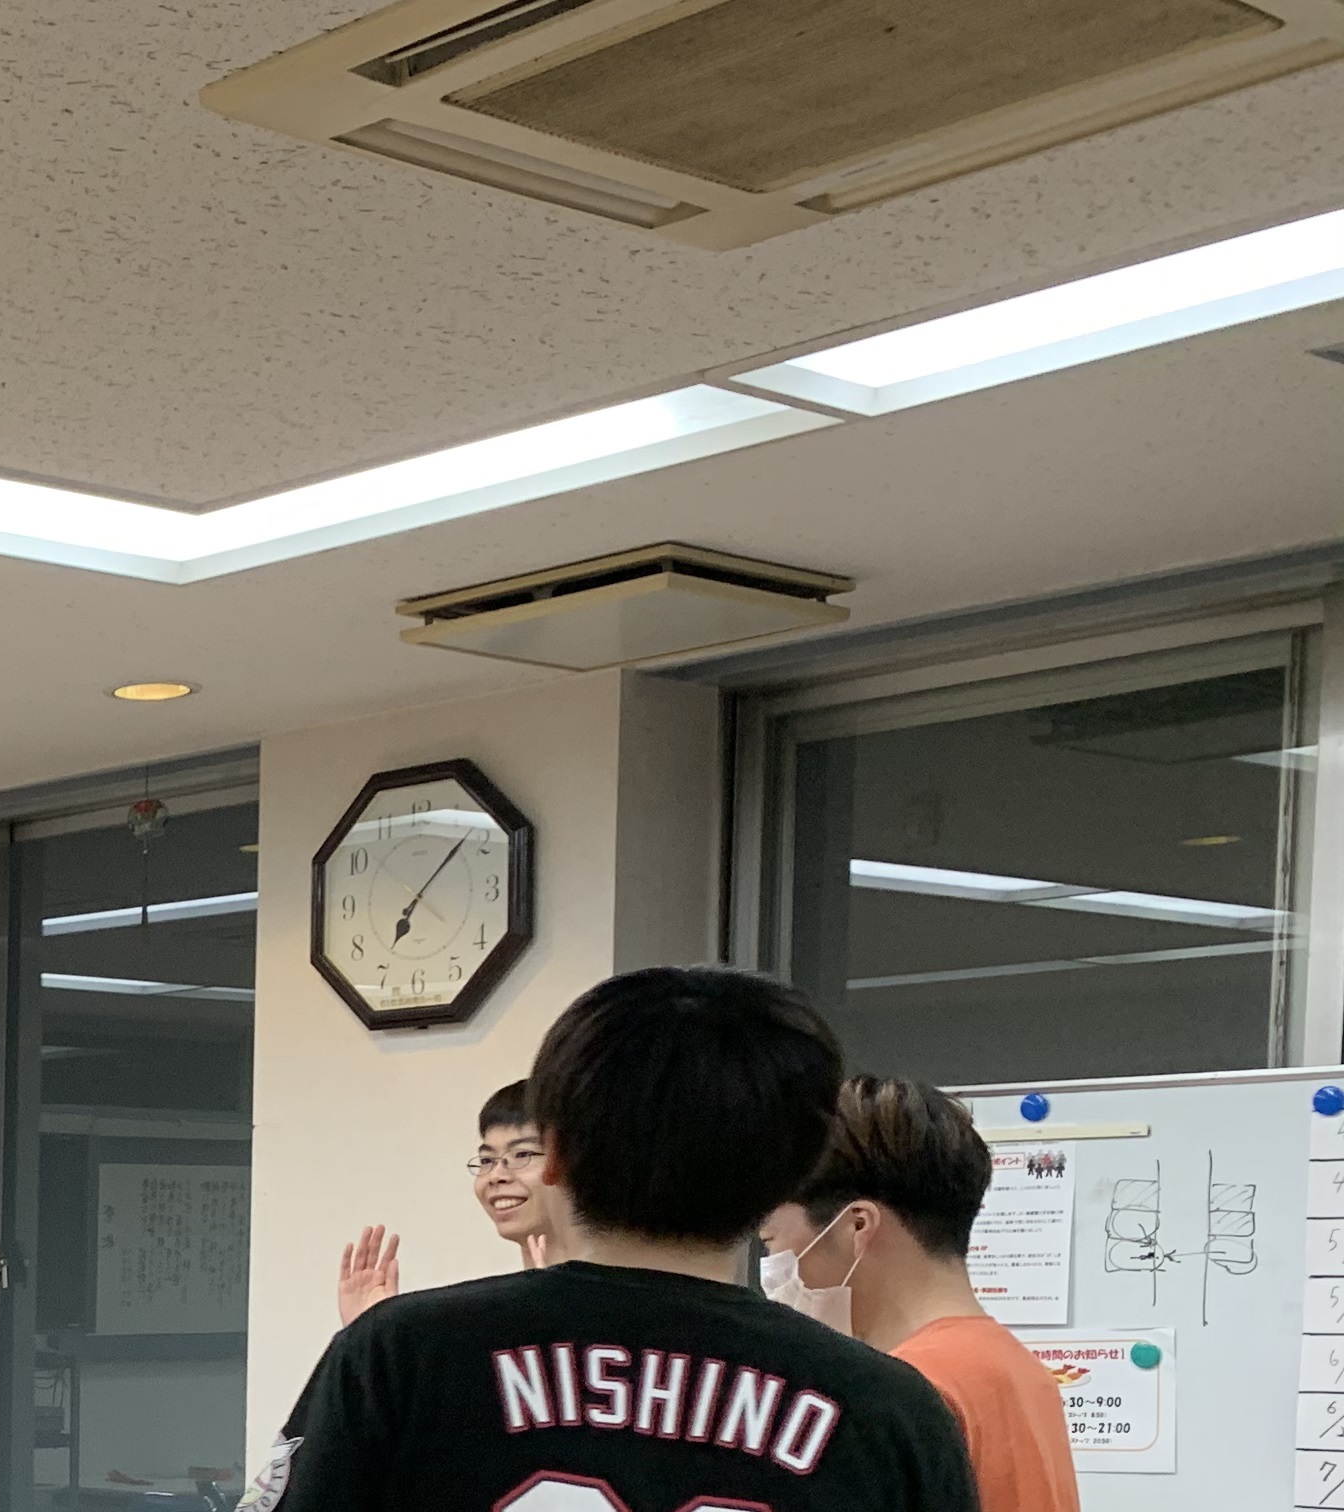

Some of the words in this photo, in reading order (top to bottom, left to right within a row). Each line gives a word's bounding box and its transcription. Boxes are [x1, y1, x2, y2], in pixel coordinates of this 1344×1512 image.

[377, 813, 393, 841] 11
[476, 829, 492, 856] 2
[349, 847, 369, 877] 10
[484, 874, 500, 902] 3
[342, 894, 356, 921] 9
[351, 933, 365, 961] 8
[472, 922, 489, 951] 4
[376, 962, 391, 990] 7
[411, 968, 426, 995] 6
[448, 956, 463, 982] 5
[491, 1342, 842, 1476] NISHINO
